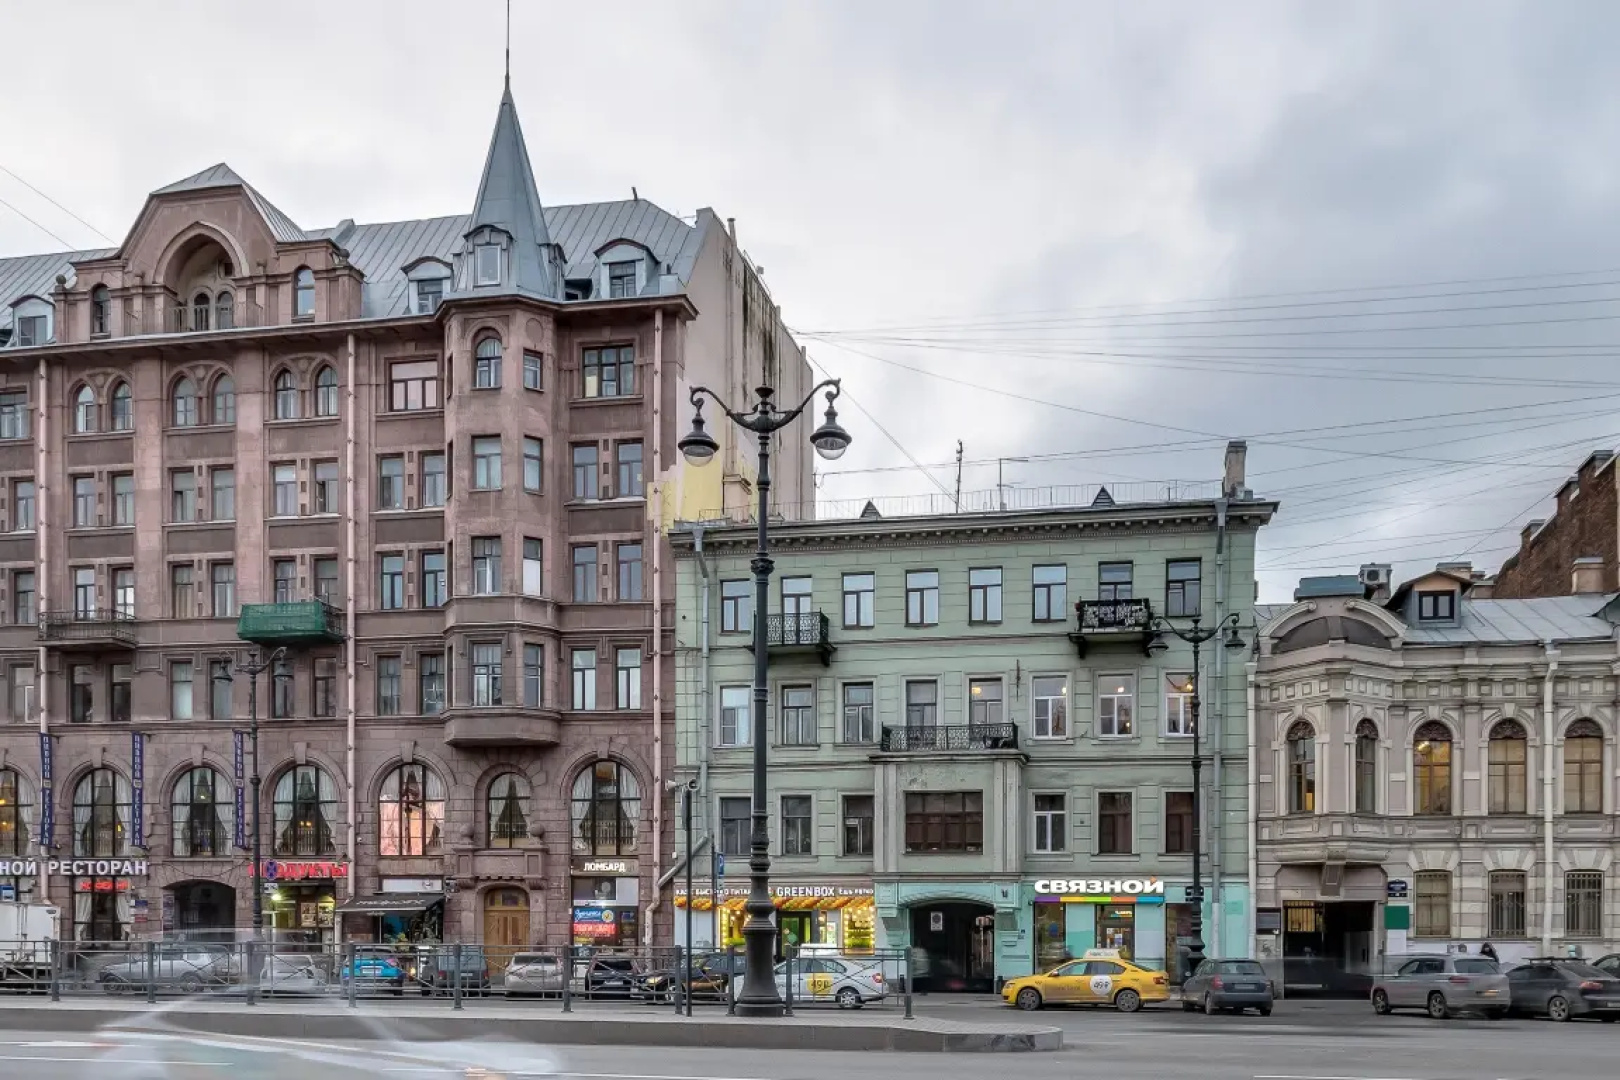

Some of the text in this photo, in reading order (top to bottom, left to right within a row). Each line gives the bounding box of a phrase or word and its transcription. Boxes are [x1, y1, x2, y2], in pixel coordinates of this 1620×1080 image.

[48, 860, 147, 875] РЕСТОРАН
[583, 862, 626, 873] ЛОМБАРД
[777, 886, 835, 897] GREENBOX
[1034, 876, 1164, 894] СВЯЗНОЙ
